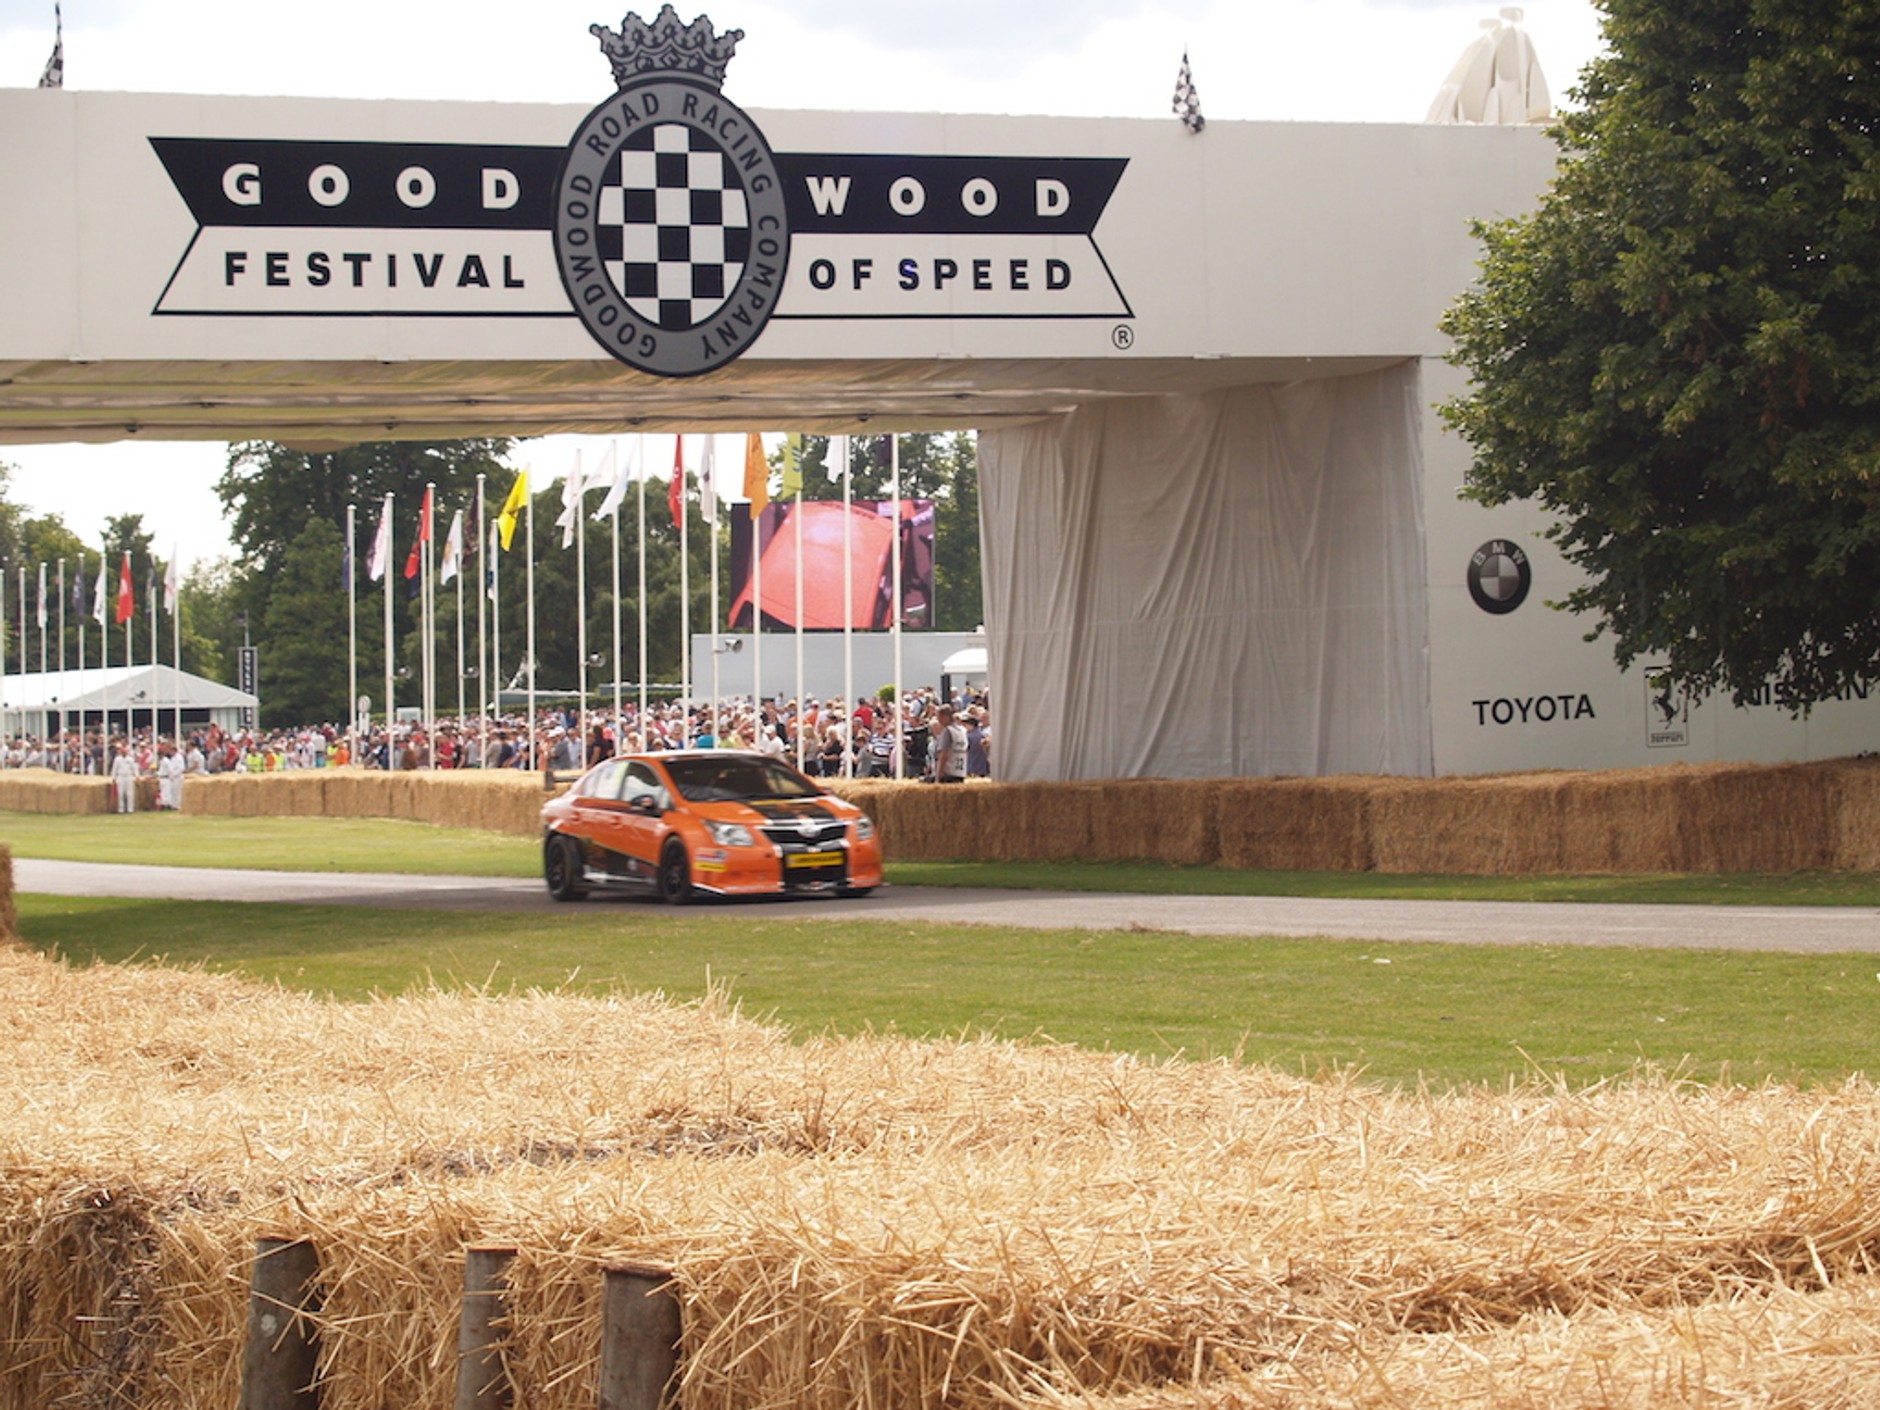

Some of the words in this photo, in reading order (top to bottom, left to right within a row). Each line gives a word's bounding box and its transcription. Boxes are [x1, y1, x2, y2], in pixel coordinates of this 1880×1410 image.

[585, 92, 660, 157] ROAD
[682, 92, 772, 194] RACING
[221, 163, 520, 209] GOOD
[805, 175, 1071, 217] WOOD
[224, 251, 525, 288] FESTIVAL
[808, 258, 874, 291] OF
[898, 258, 1072, 292] SPEED
[567, 174, 657, 358] GOODWOOD
[701, 215, 780, 360] COMPANY
[1473, 541, 1526, 566] BMW
[1472, 693, 1596, 726] TOYOTA
[1739, 676, 1868, 706] ISN
